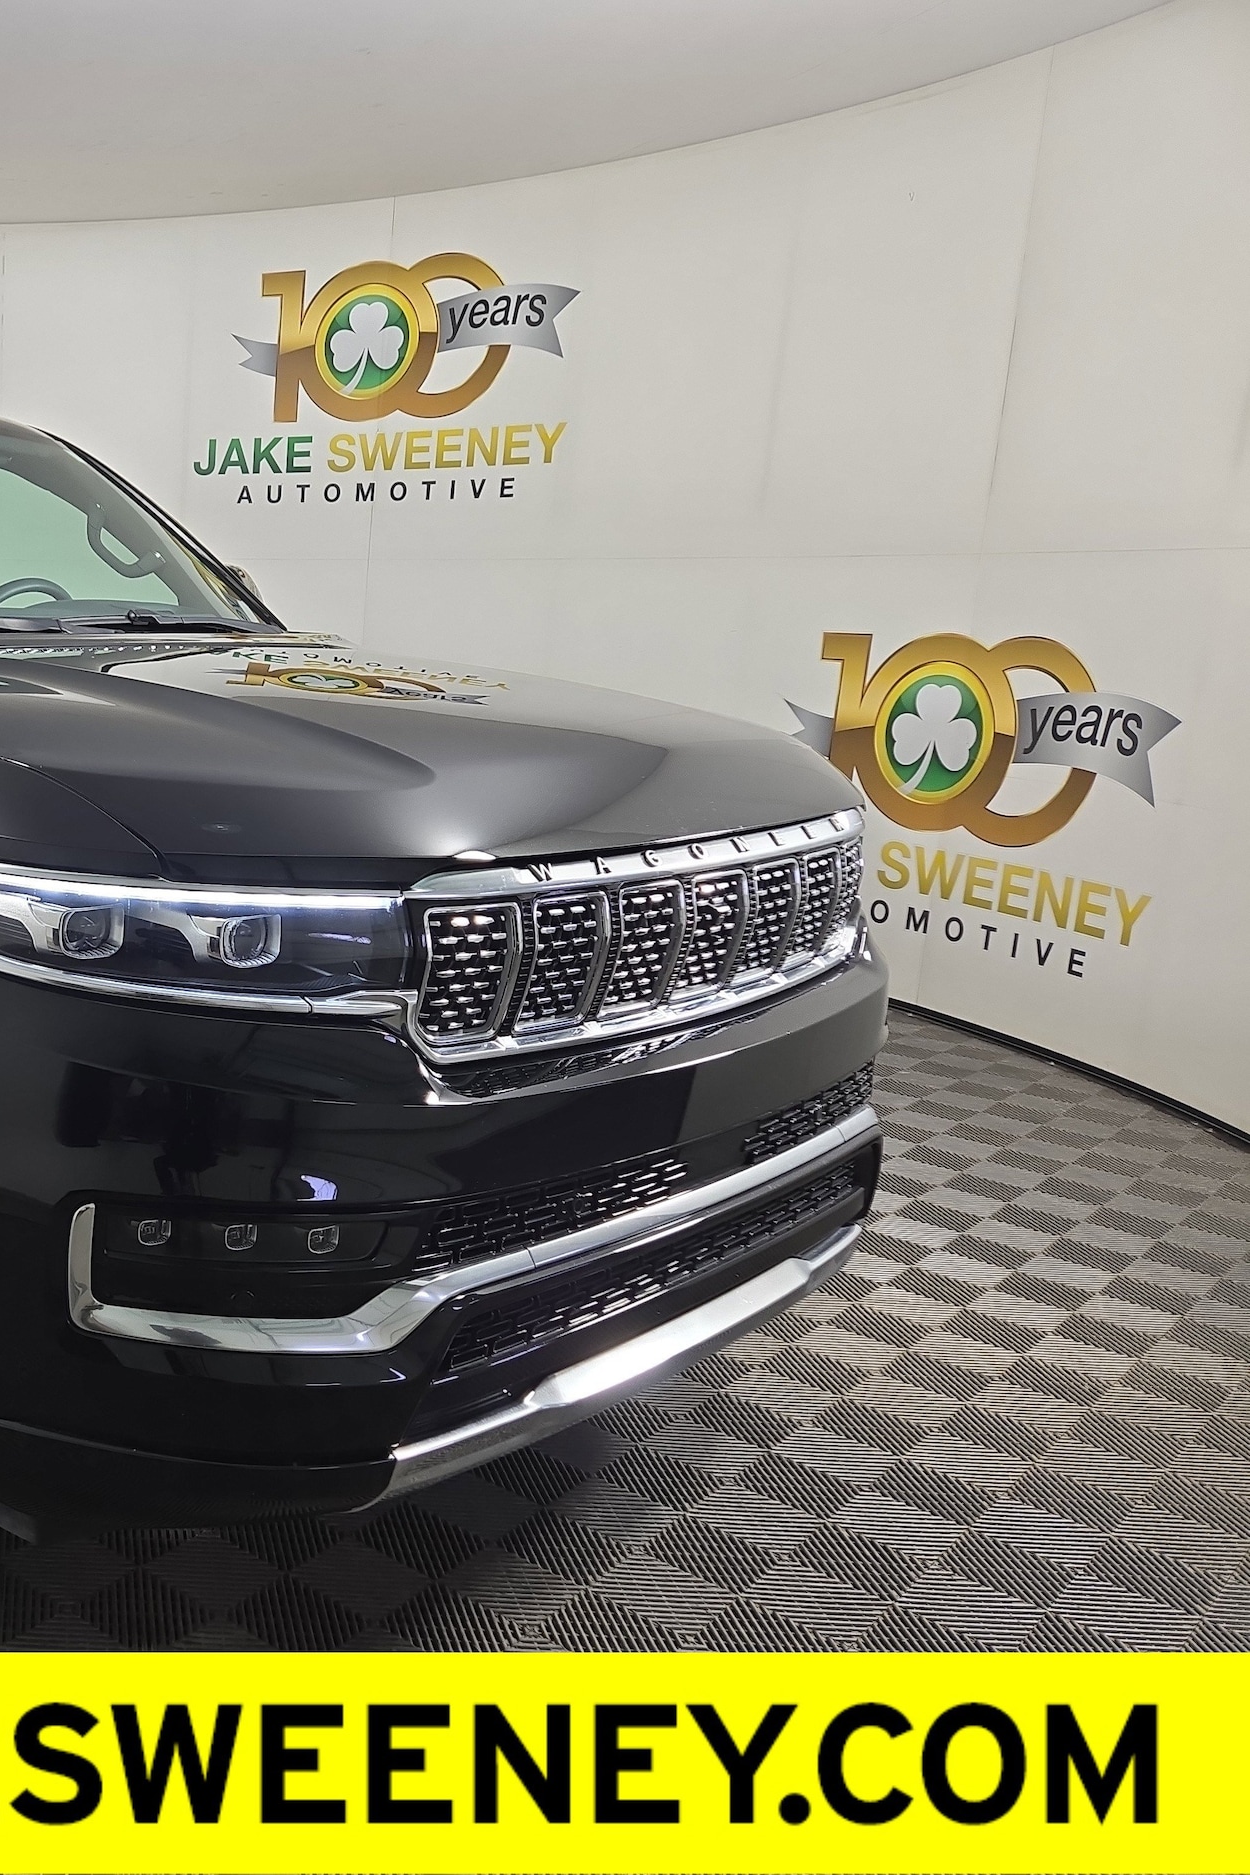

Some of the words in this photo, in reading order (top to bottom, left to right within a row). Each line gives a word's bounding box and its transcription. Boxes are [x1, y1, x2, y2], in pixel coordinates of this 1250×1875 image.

[446, 292, 547, 344] years
[193, 436, 313, 476] JAKE
[327, 422, 567, 473] SWEENEY
[237, 477, 516, 504] AUTOMOTIVE
[1023, 703, 1143, 757] years
[527, 817, 844, 883] WAGONEER
[877, 842, 1152, 947] SWEENEY
[870, 899, 1087, 978] OMOTIVE
